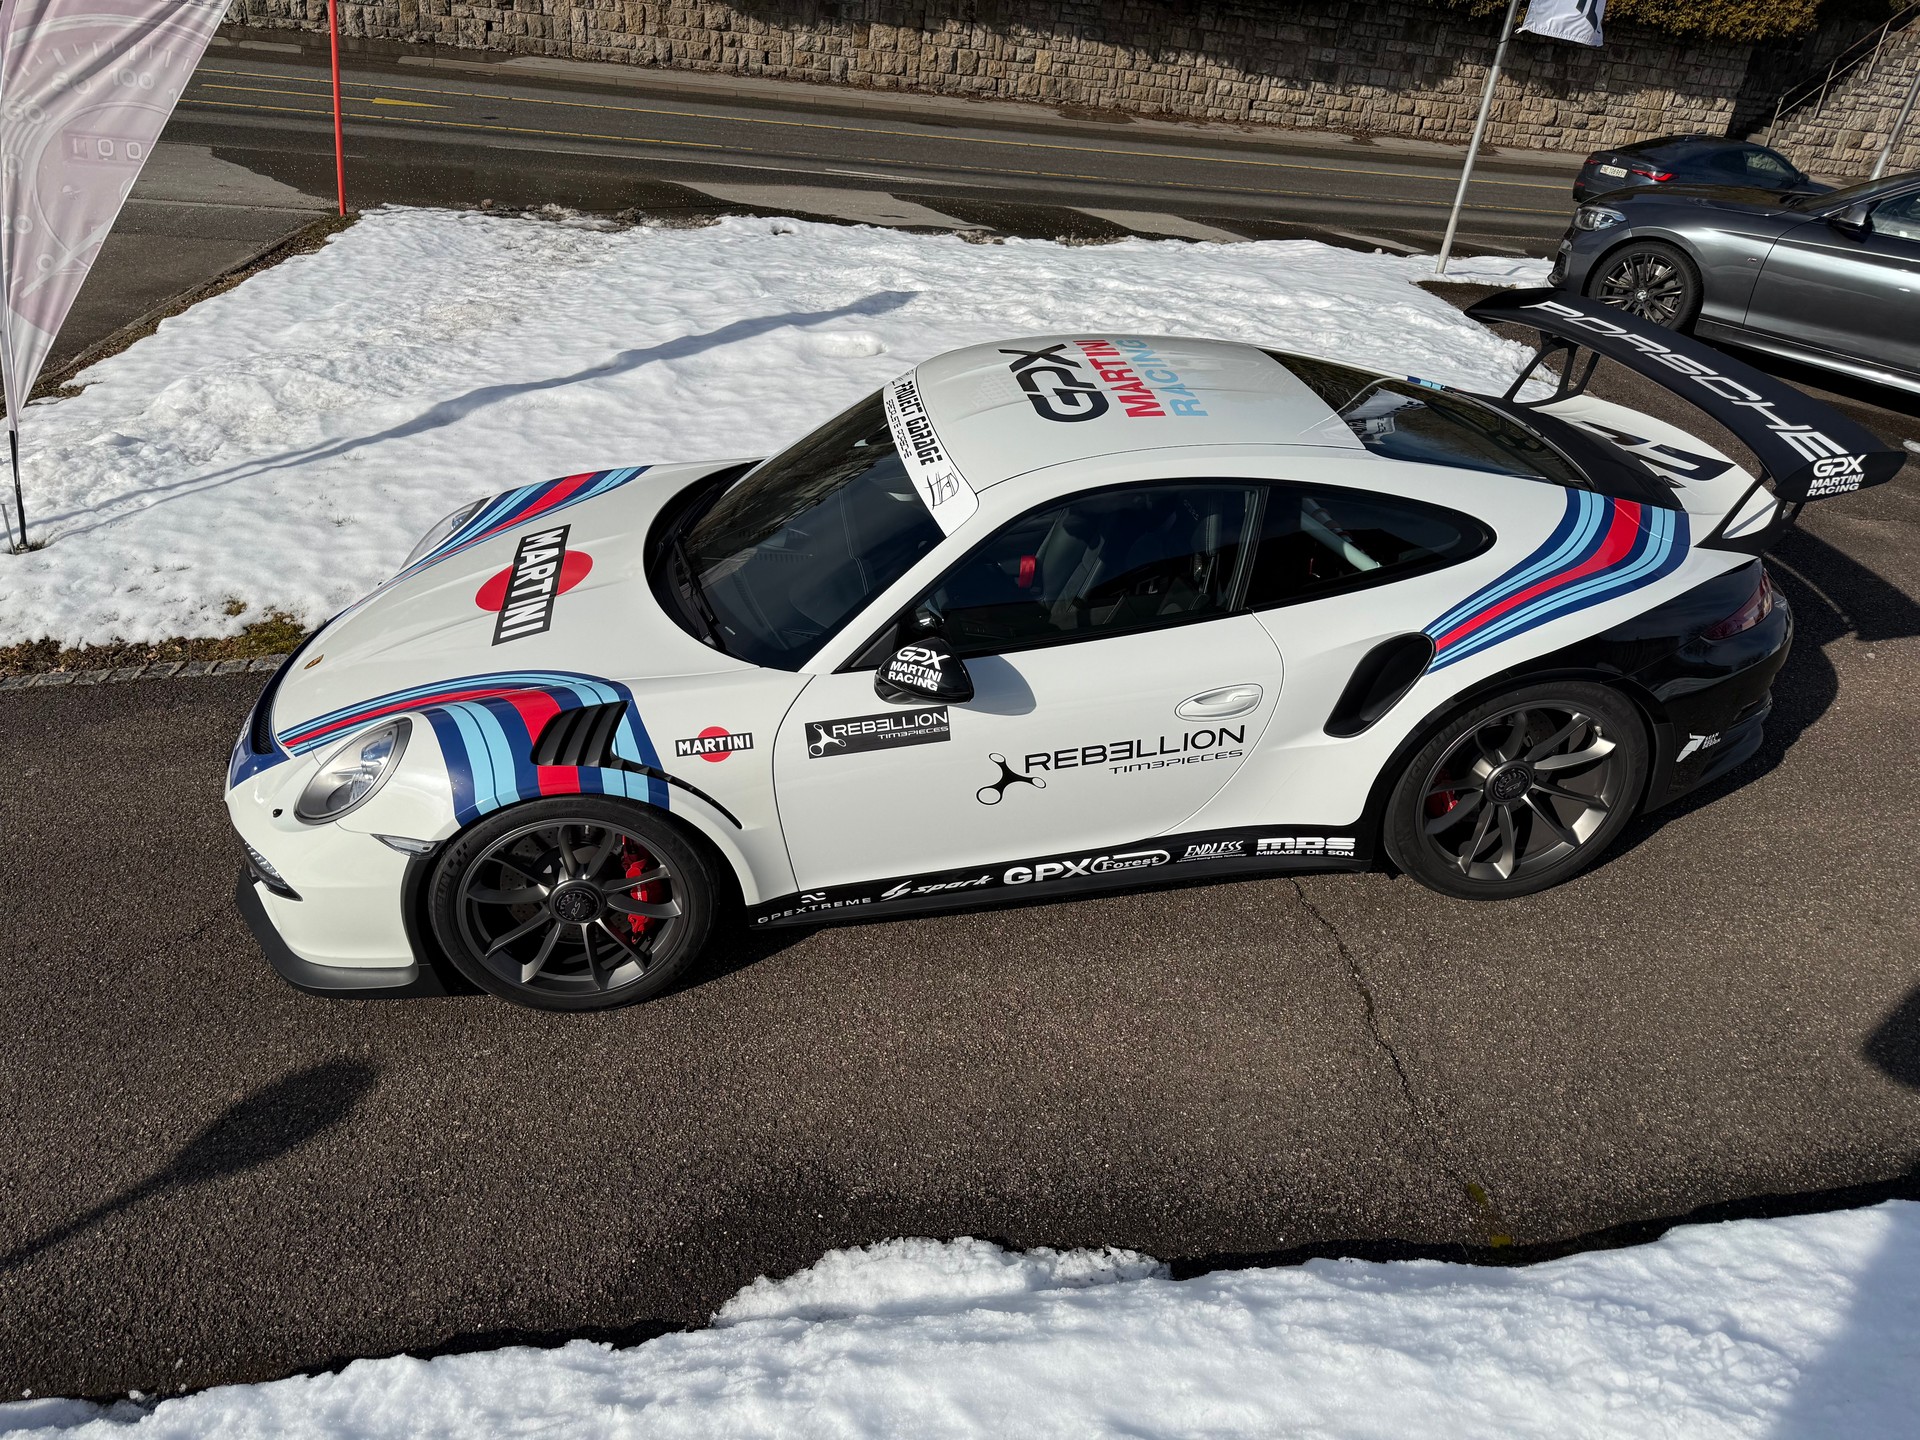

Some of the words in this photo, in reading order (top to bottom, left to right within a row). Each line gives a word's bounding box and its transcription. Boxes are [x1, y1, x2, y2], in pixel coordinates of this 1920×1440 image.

[109, 67, 155, 91] 100
[998, 343, 1110, 423] GPX
[1072, 339, 1167, 418] MARTINI
[1115, 339, 1210, 417] RACING
[1520, 300, 1849, 463] PORSCHE
[894, 380, 923, 417] PROJECT
[905, 415, 943, 466] GARAGE
[1813, 454, 1867, 478] GPX
[1806, 482, 1860, 497] RACING
[1810, 473, 1865, 489] MARTINI
[499, 528, 565, 640] MARTINI
[896, 646, 951, 670] GPX
[888, 670, 939, 692] RACING
[890, 660, 943, 683] MARTINI
[678, 734, 752, 756] MARTINI
[1184, 840, 1244, 857] ENDLESS
[1003, 857, 1095, 886] GPX
[1101, 854, 1160, 871] Forest
[757, 897, 872, 924] GPEXTREME
